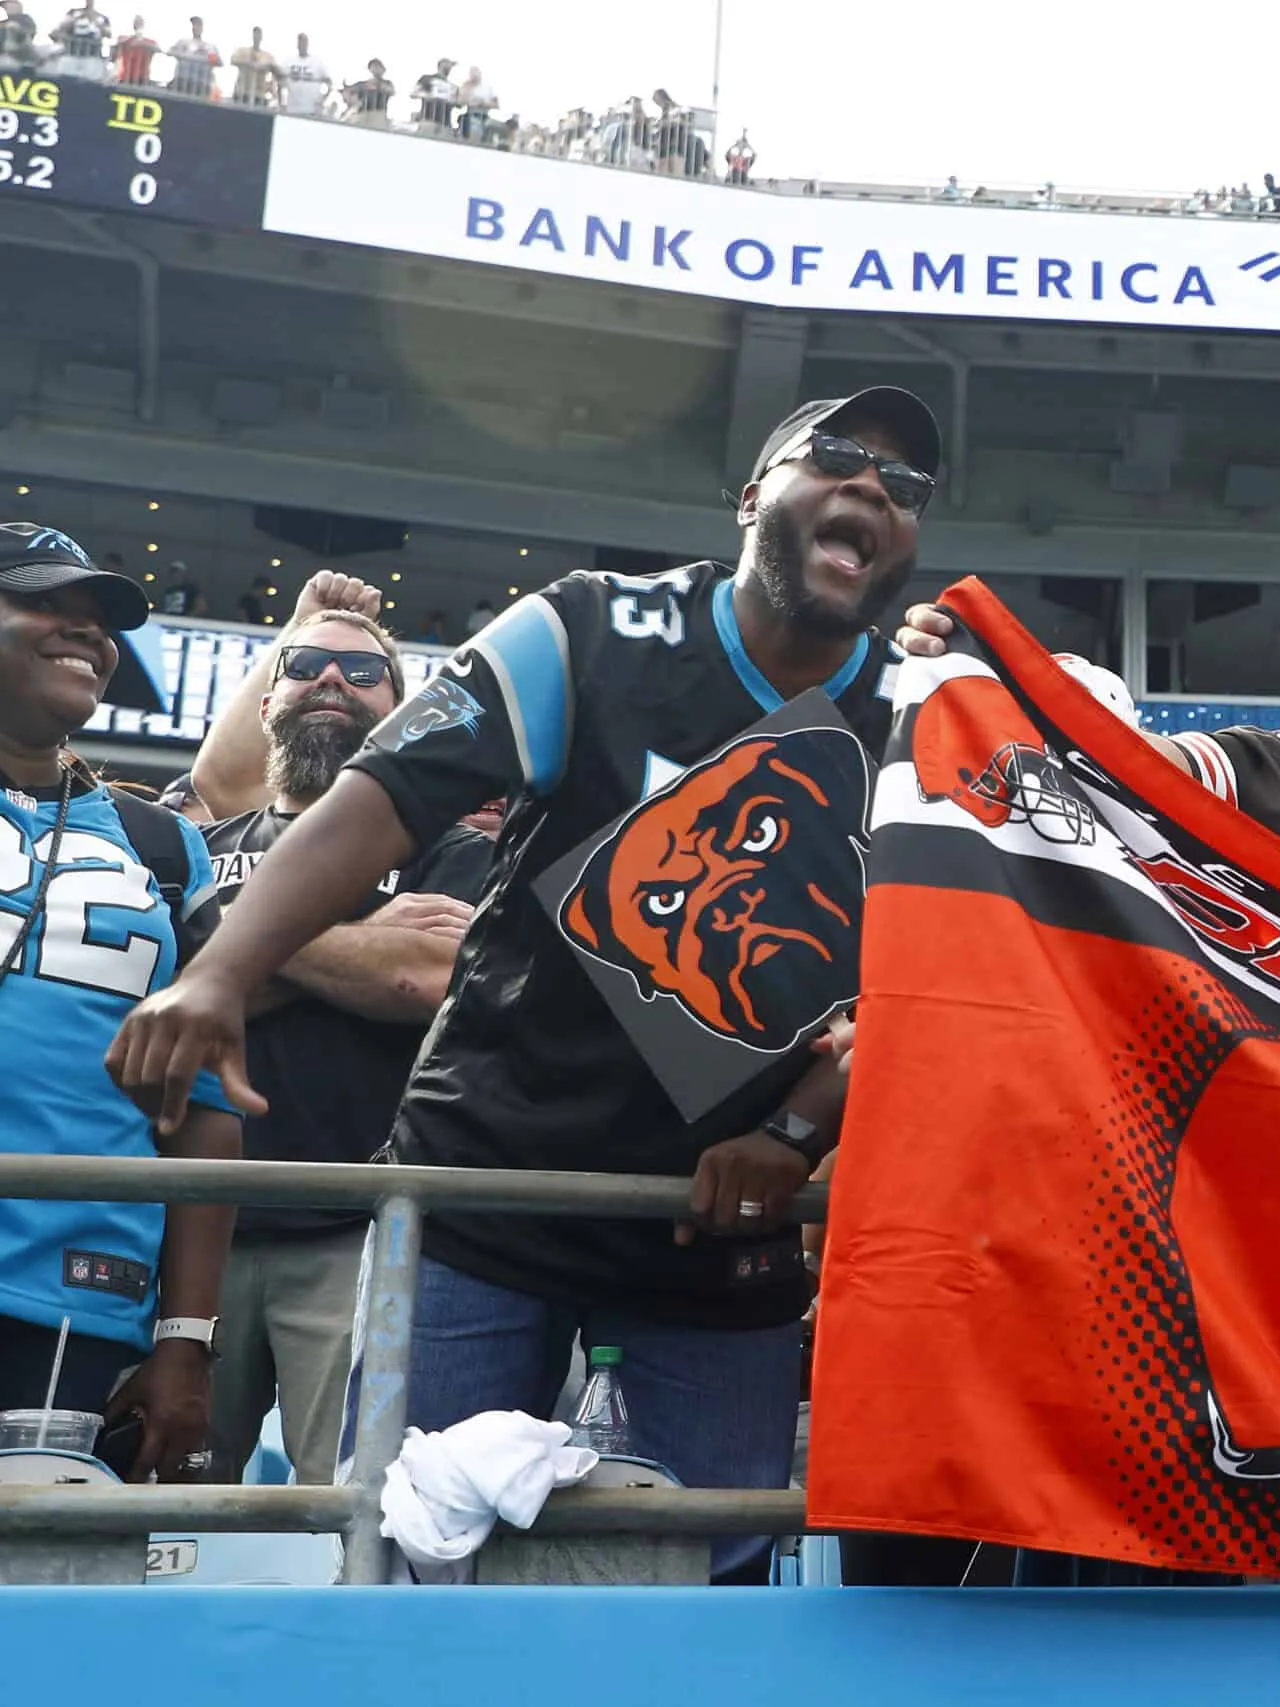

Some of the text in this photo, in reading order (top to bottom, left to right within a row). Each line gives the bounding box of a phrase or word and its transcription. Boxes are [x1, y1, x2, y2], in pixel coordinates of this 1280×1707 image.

[0, 75, 163, 127] VG TD
[134, 133, 162, 164] 0
[129, 172, 157, 205] 0
[465, 195, 694, 272] BANK
[724, 237, 825, 286] OF
[848, 248, 1217, 307] AMERICA
[0, 813, 164, 1001] 2
[148, 1547, 180, 1571] 21
